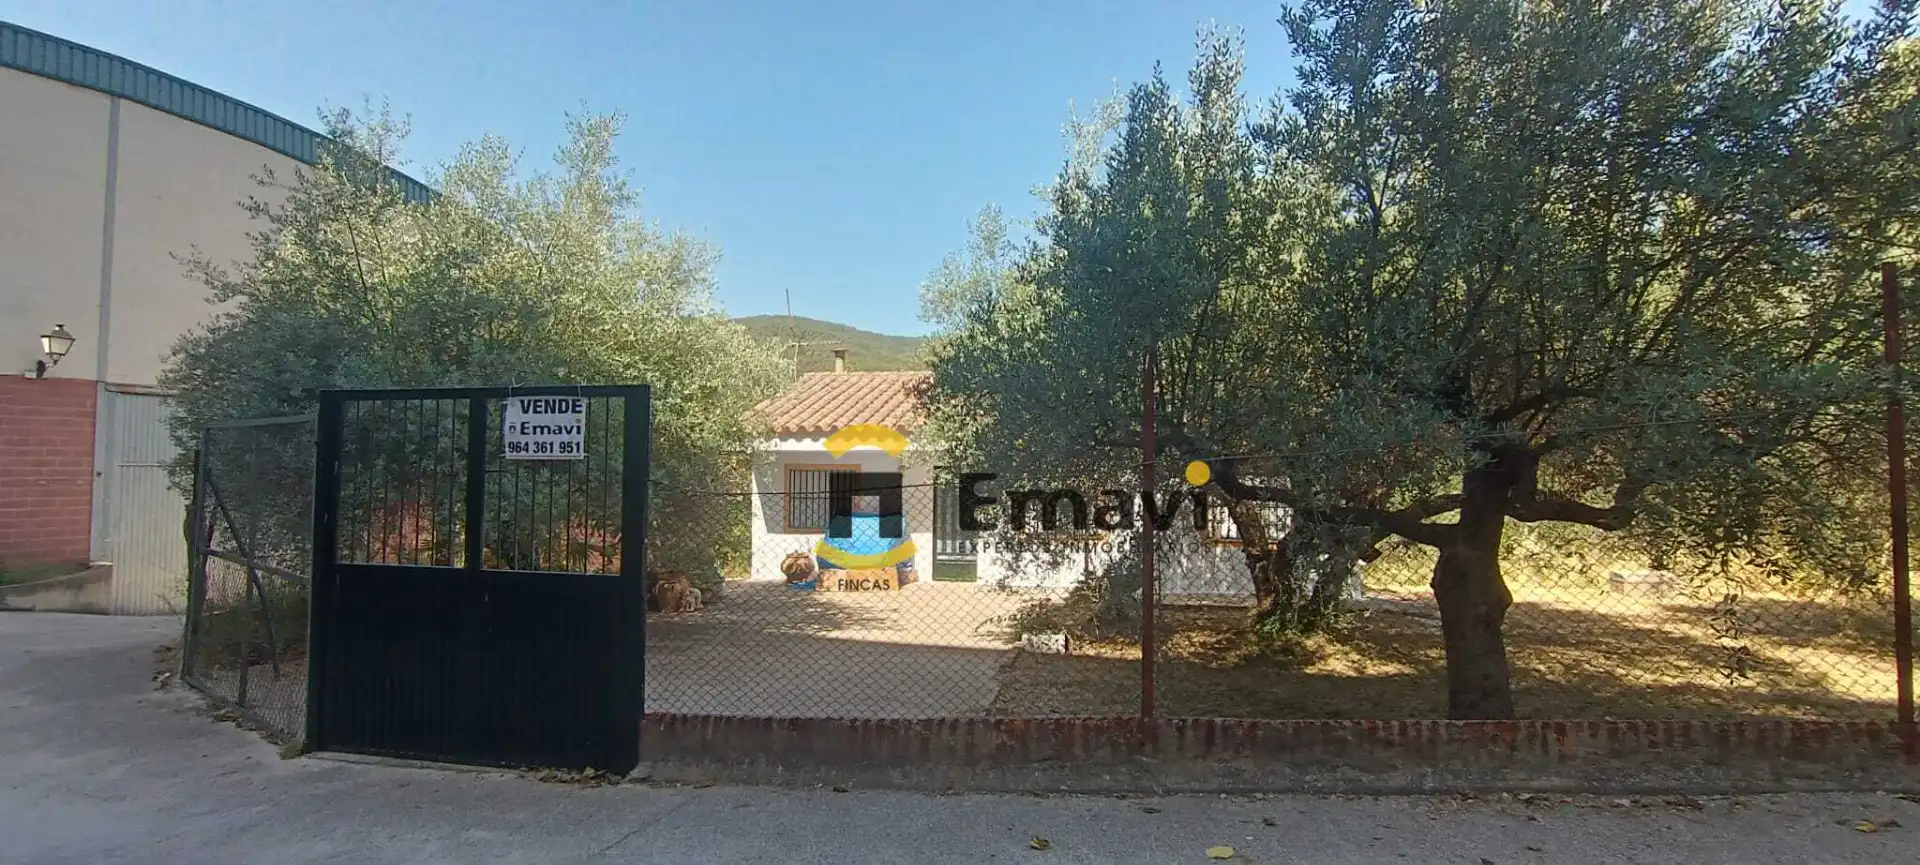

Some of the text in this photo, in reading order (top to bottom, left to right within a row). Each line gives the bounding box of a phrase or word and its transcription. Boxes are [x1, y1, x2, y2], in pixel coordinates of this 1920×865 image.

[520, 399, 583, 414] VENDE
[520, 419, 581, 435] Emavi
[508, 441, 580, 454] 964 361 951
